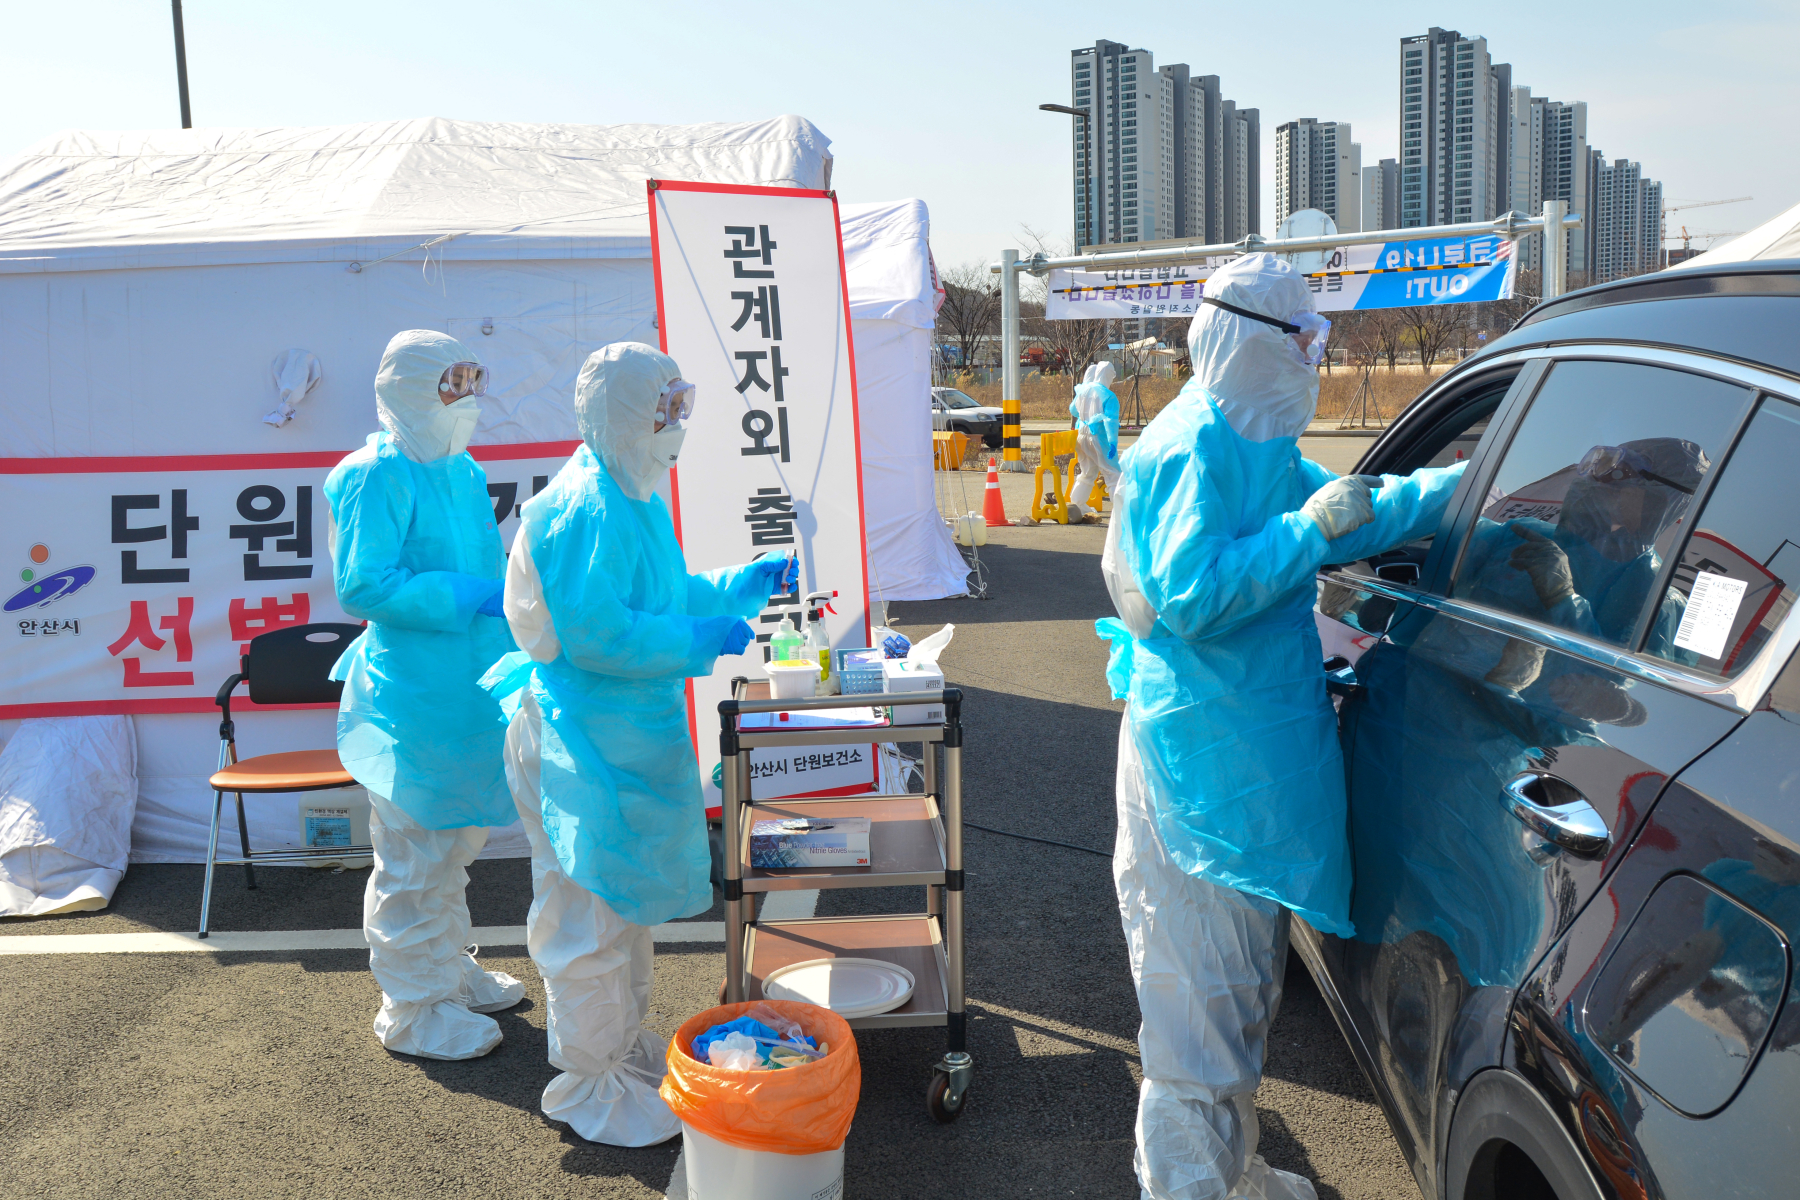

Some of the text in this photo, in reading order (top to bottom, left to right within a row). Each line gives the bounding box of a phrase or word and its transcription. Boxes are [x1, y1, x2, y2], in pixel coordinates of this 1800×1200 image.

[723, 224, 791, 463] 관계자외
[17, 618, 81, 636] 안산시
[750, 748, 863, 779] 안산시 단원보건소
[778, 841, 793, 849] Blue
[809, 847, 827, 855] Nitrile
[828, 847, 848, 855] Gloves
